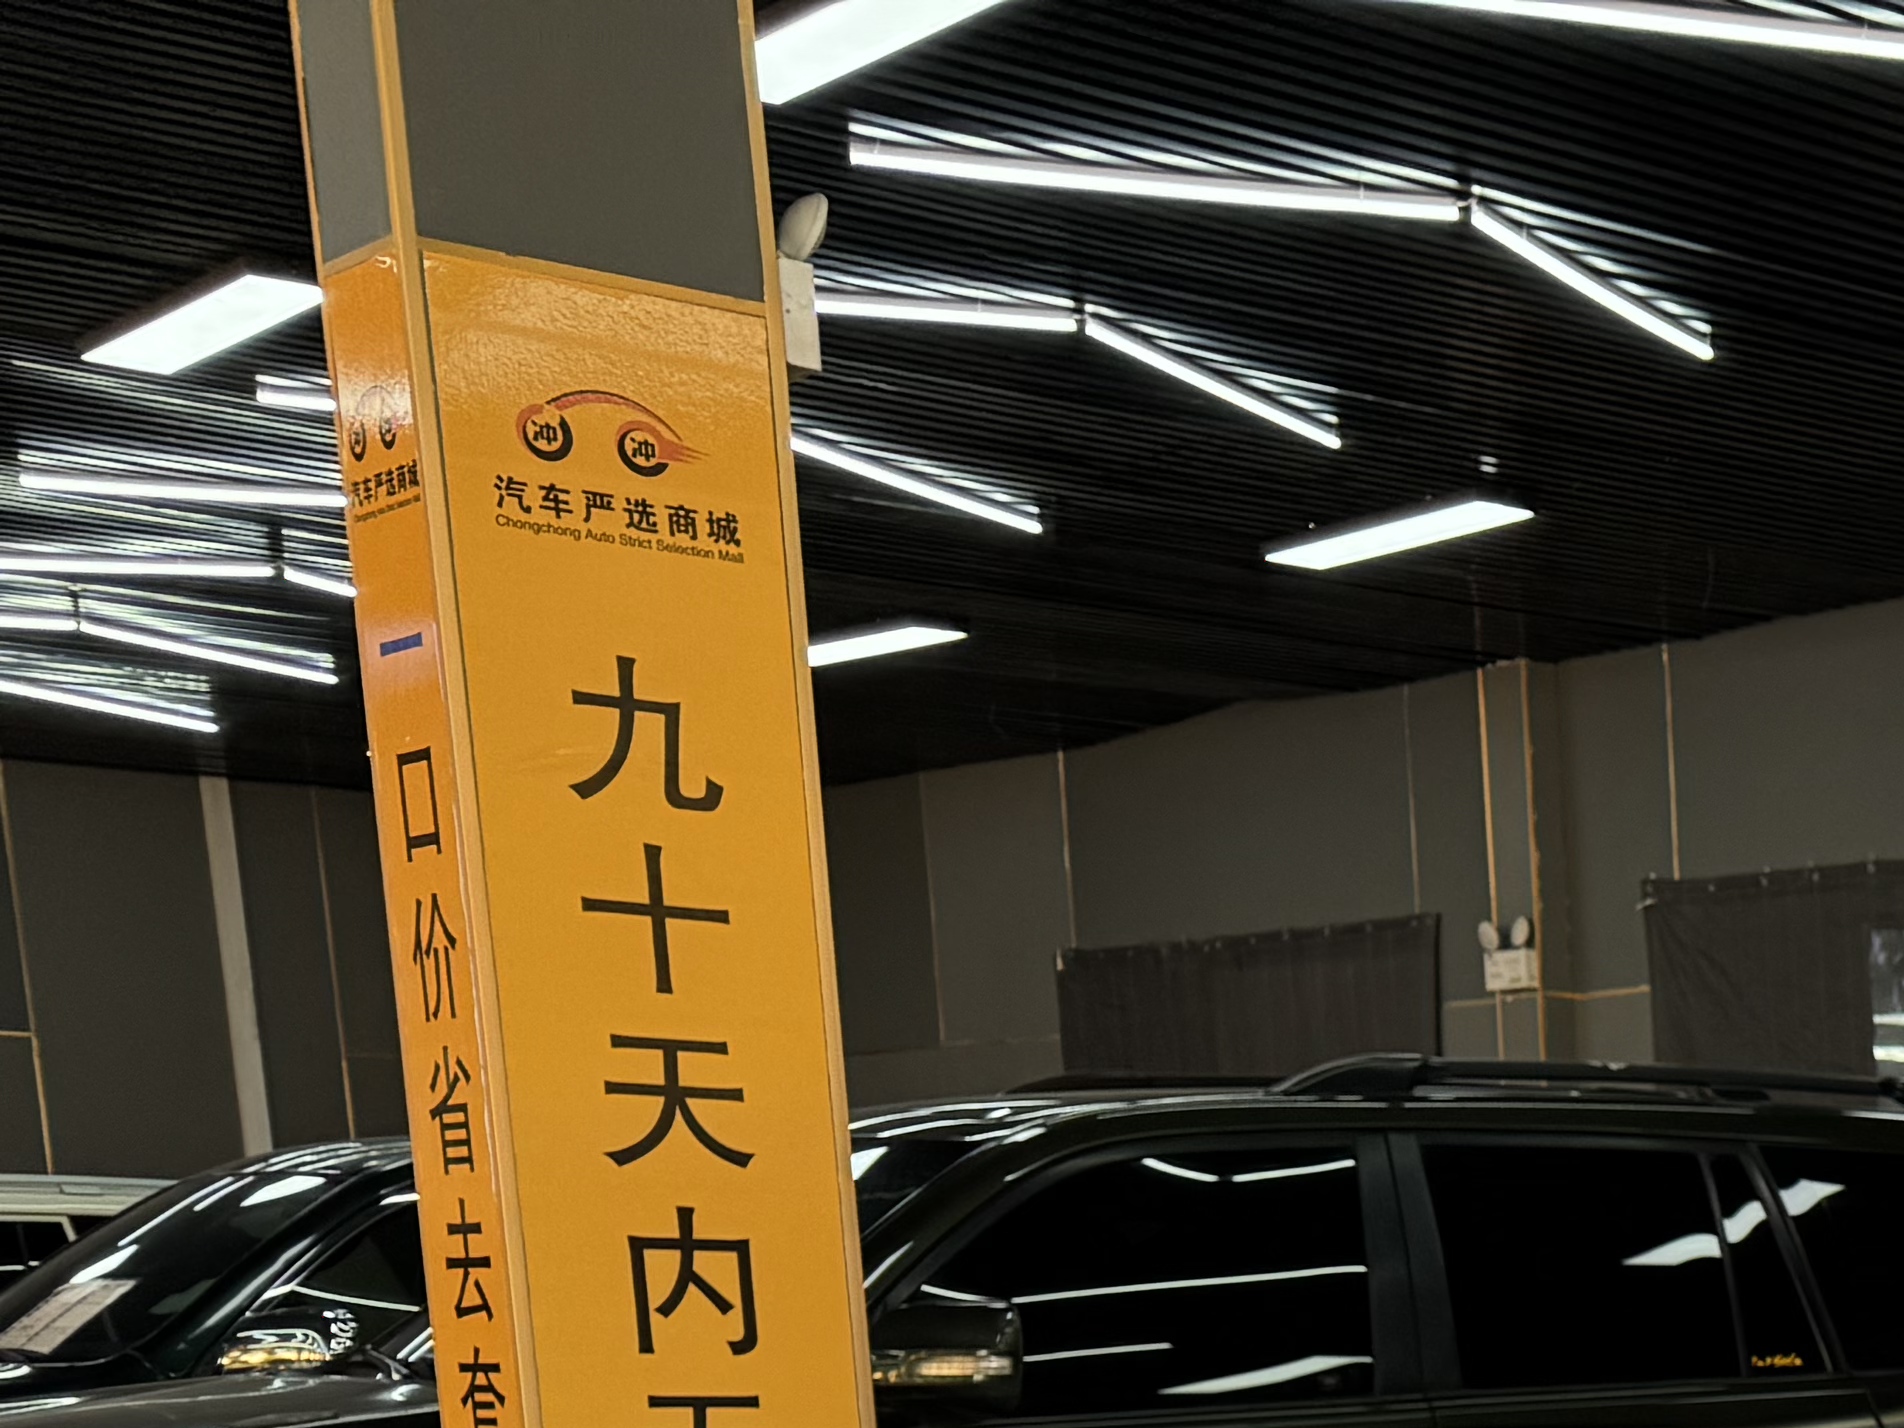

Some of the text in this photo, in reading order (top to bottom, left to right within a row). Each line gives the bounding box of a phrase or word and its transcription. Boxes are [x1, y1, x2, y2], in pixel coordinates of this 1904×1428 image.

[493, 474, 742, 549] 汽车严选商城
[494, 513, 745, 564] Chongchong Auto Strict Selection Mall
